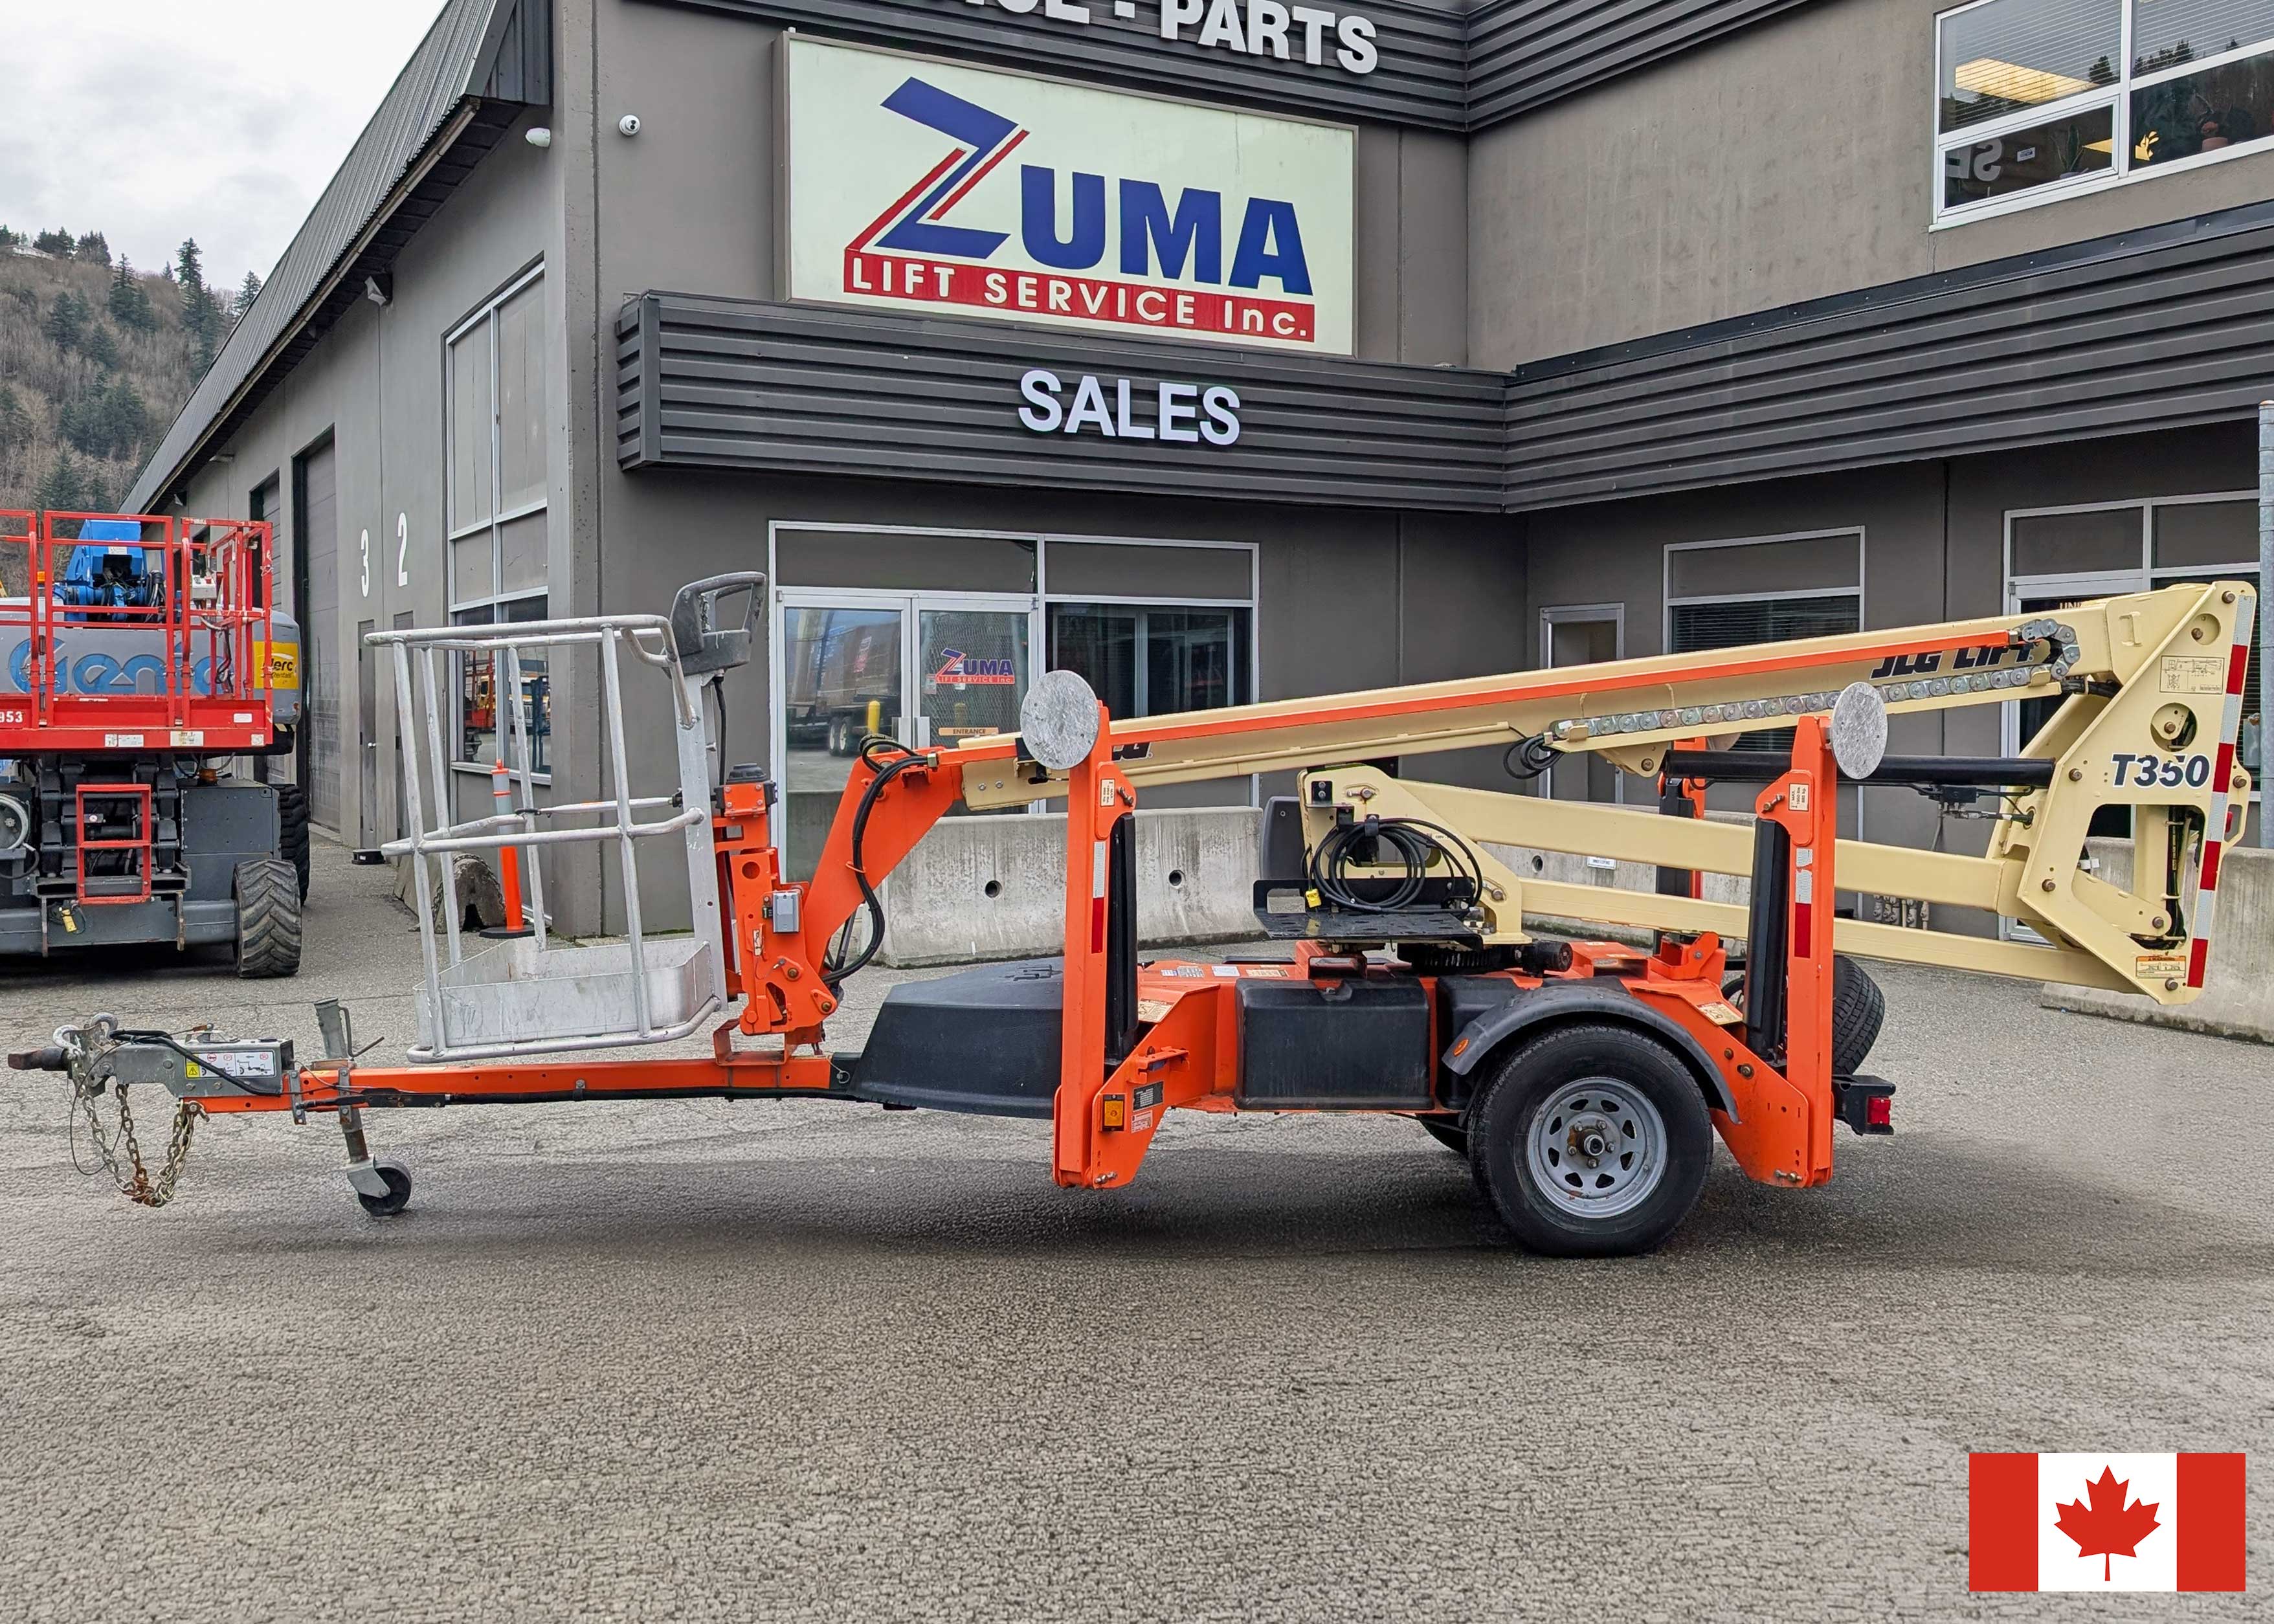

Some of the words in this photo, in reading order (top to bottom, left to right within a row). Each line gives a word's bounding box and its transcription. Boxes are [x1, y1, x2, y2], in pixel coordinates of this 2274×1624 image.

[1161, 0, 1378, 74] PARTS
[848, 76, 1314, 296] ZUMA
[853, 257, 955, 298] LIFT
[983, 273, 1196, 325] SERVICE
[1224, 300, 1307, 337] Inc.
[1018, 369, 1240, 445] SALES
[361, 528, 370, 597] 3
[397, 512, 408, 587] 2
[940, 648, 1014, 676] ZUMA
[2110, 752, 2211, 788] T350
